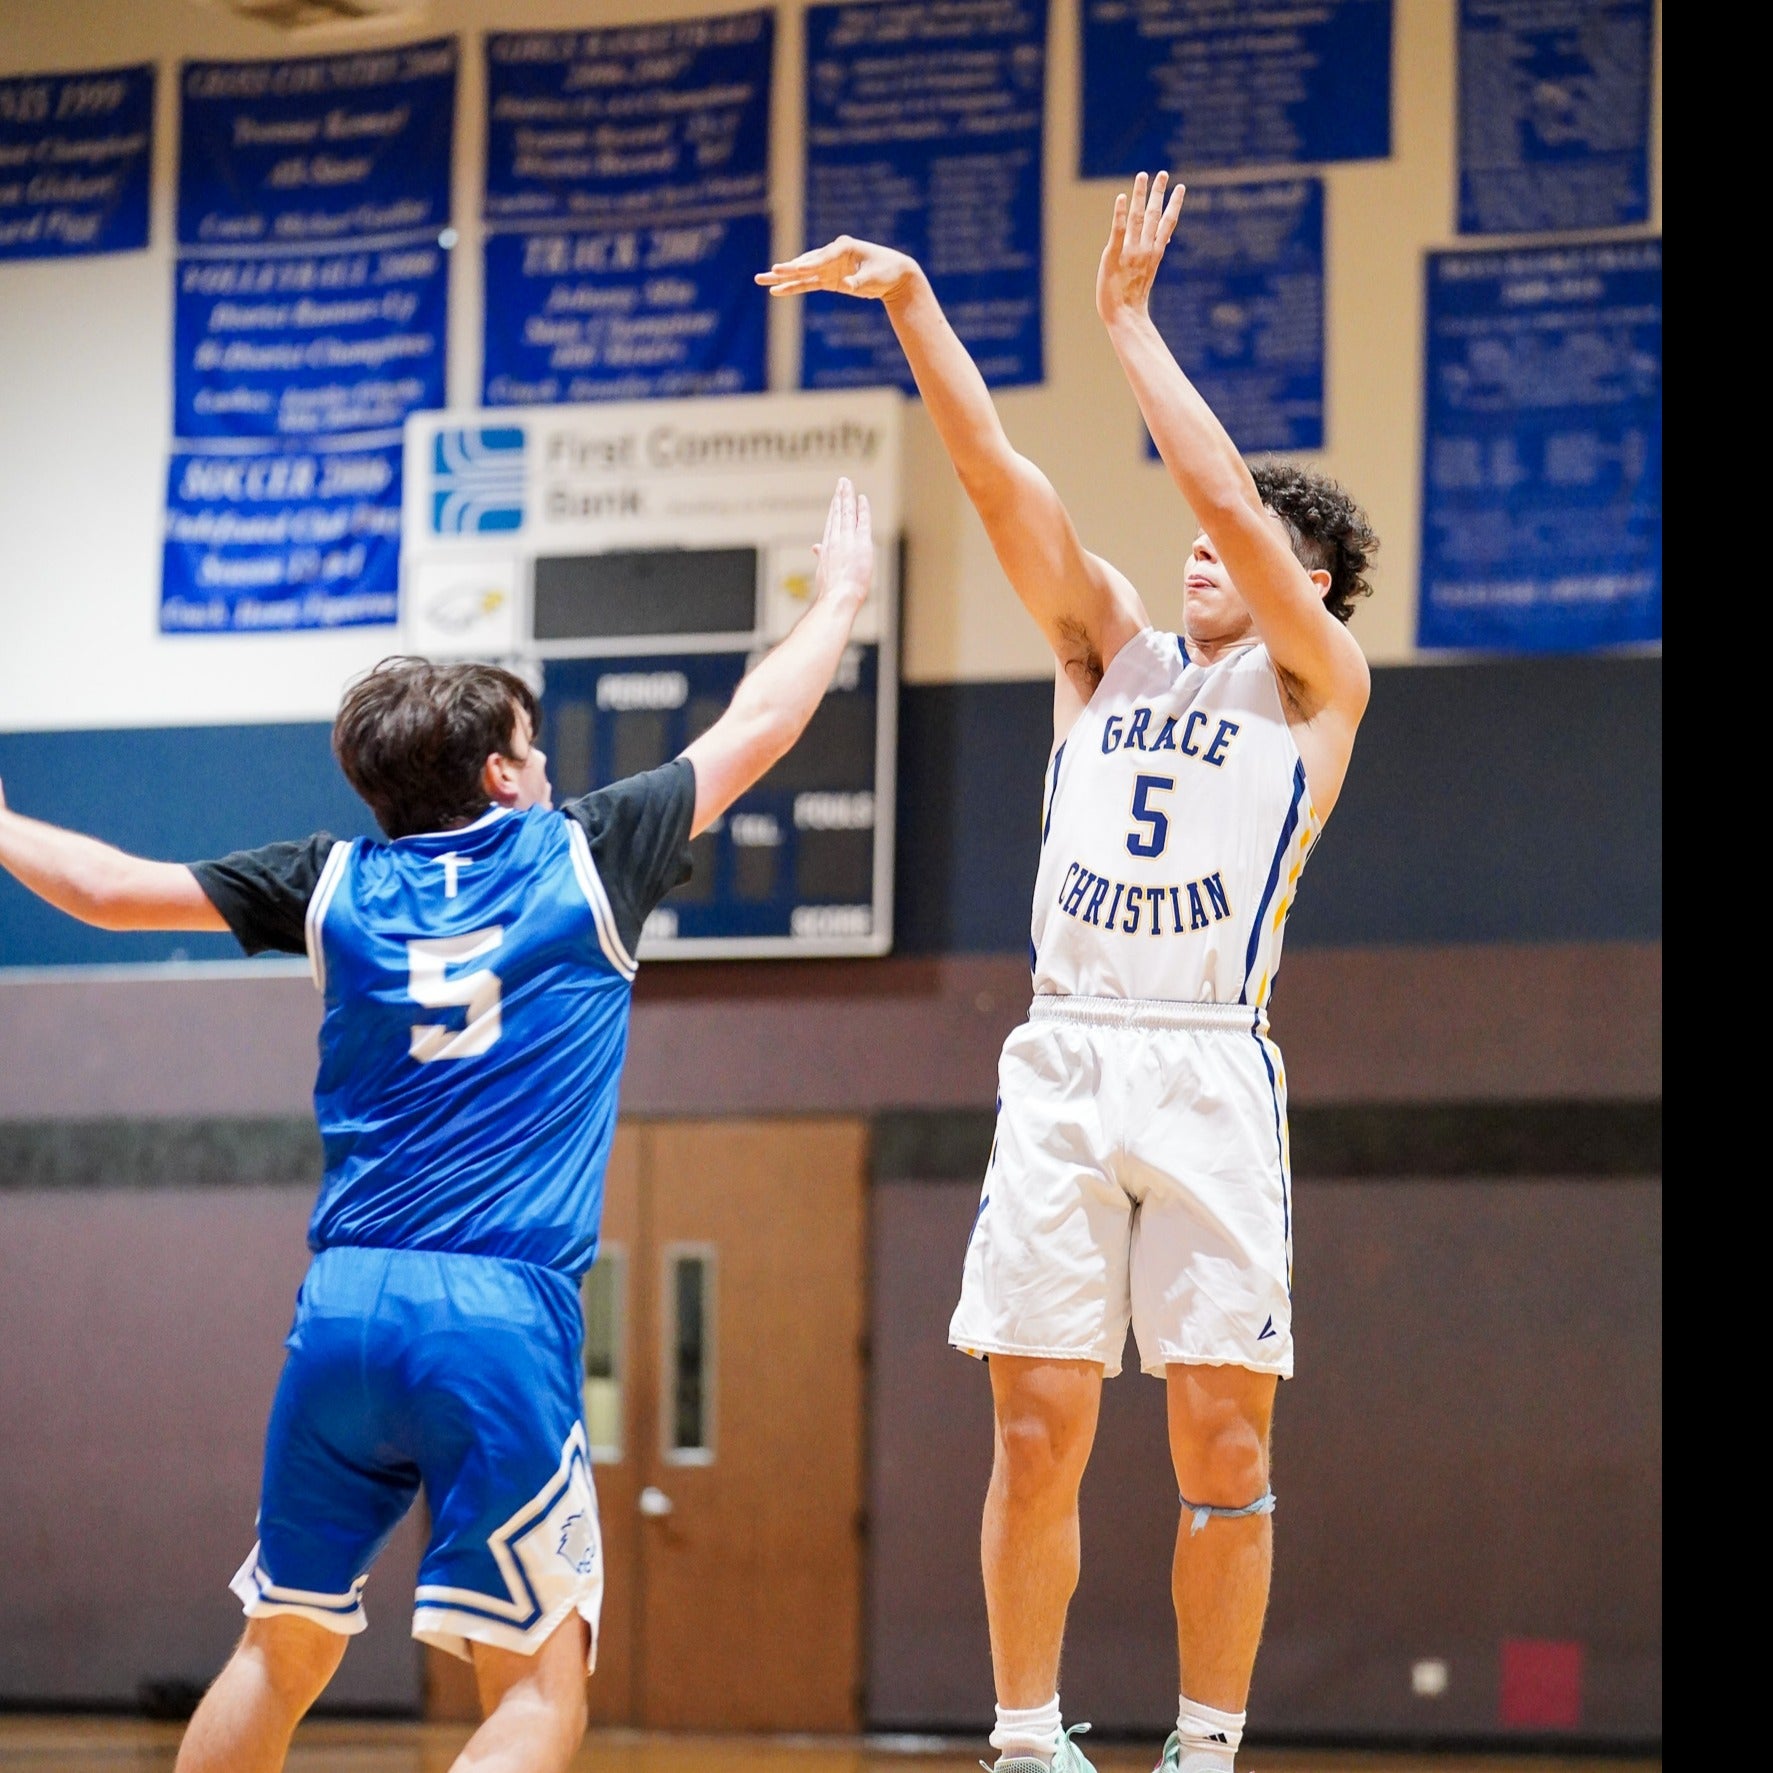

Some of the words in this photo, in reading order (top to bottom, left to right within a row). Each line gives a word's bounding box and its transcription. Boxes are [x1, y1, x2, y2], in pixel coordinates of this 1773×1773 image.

[547, 430, 638, 465] First
[647, 419, 880, 468] Community
[180, 457, 316, 500] SOCCER
[547, 487, 641, 522] Bank
[1101, 706, 1240, 768] GRACE
[1125, 773, 1176, 860] 5
[1058, 862, 1232, 936] CHRISTIAN
[407, 925, 503, 1064] 5
